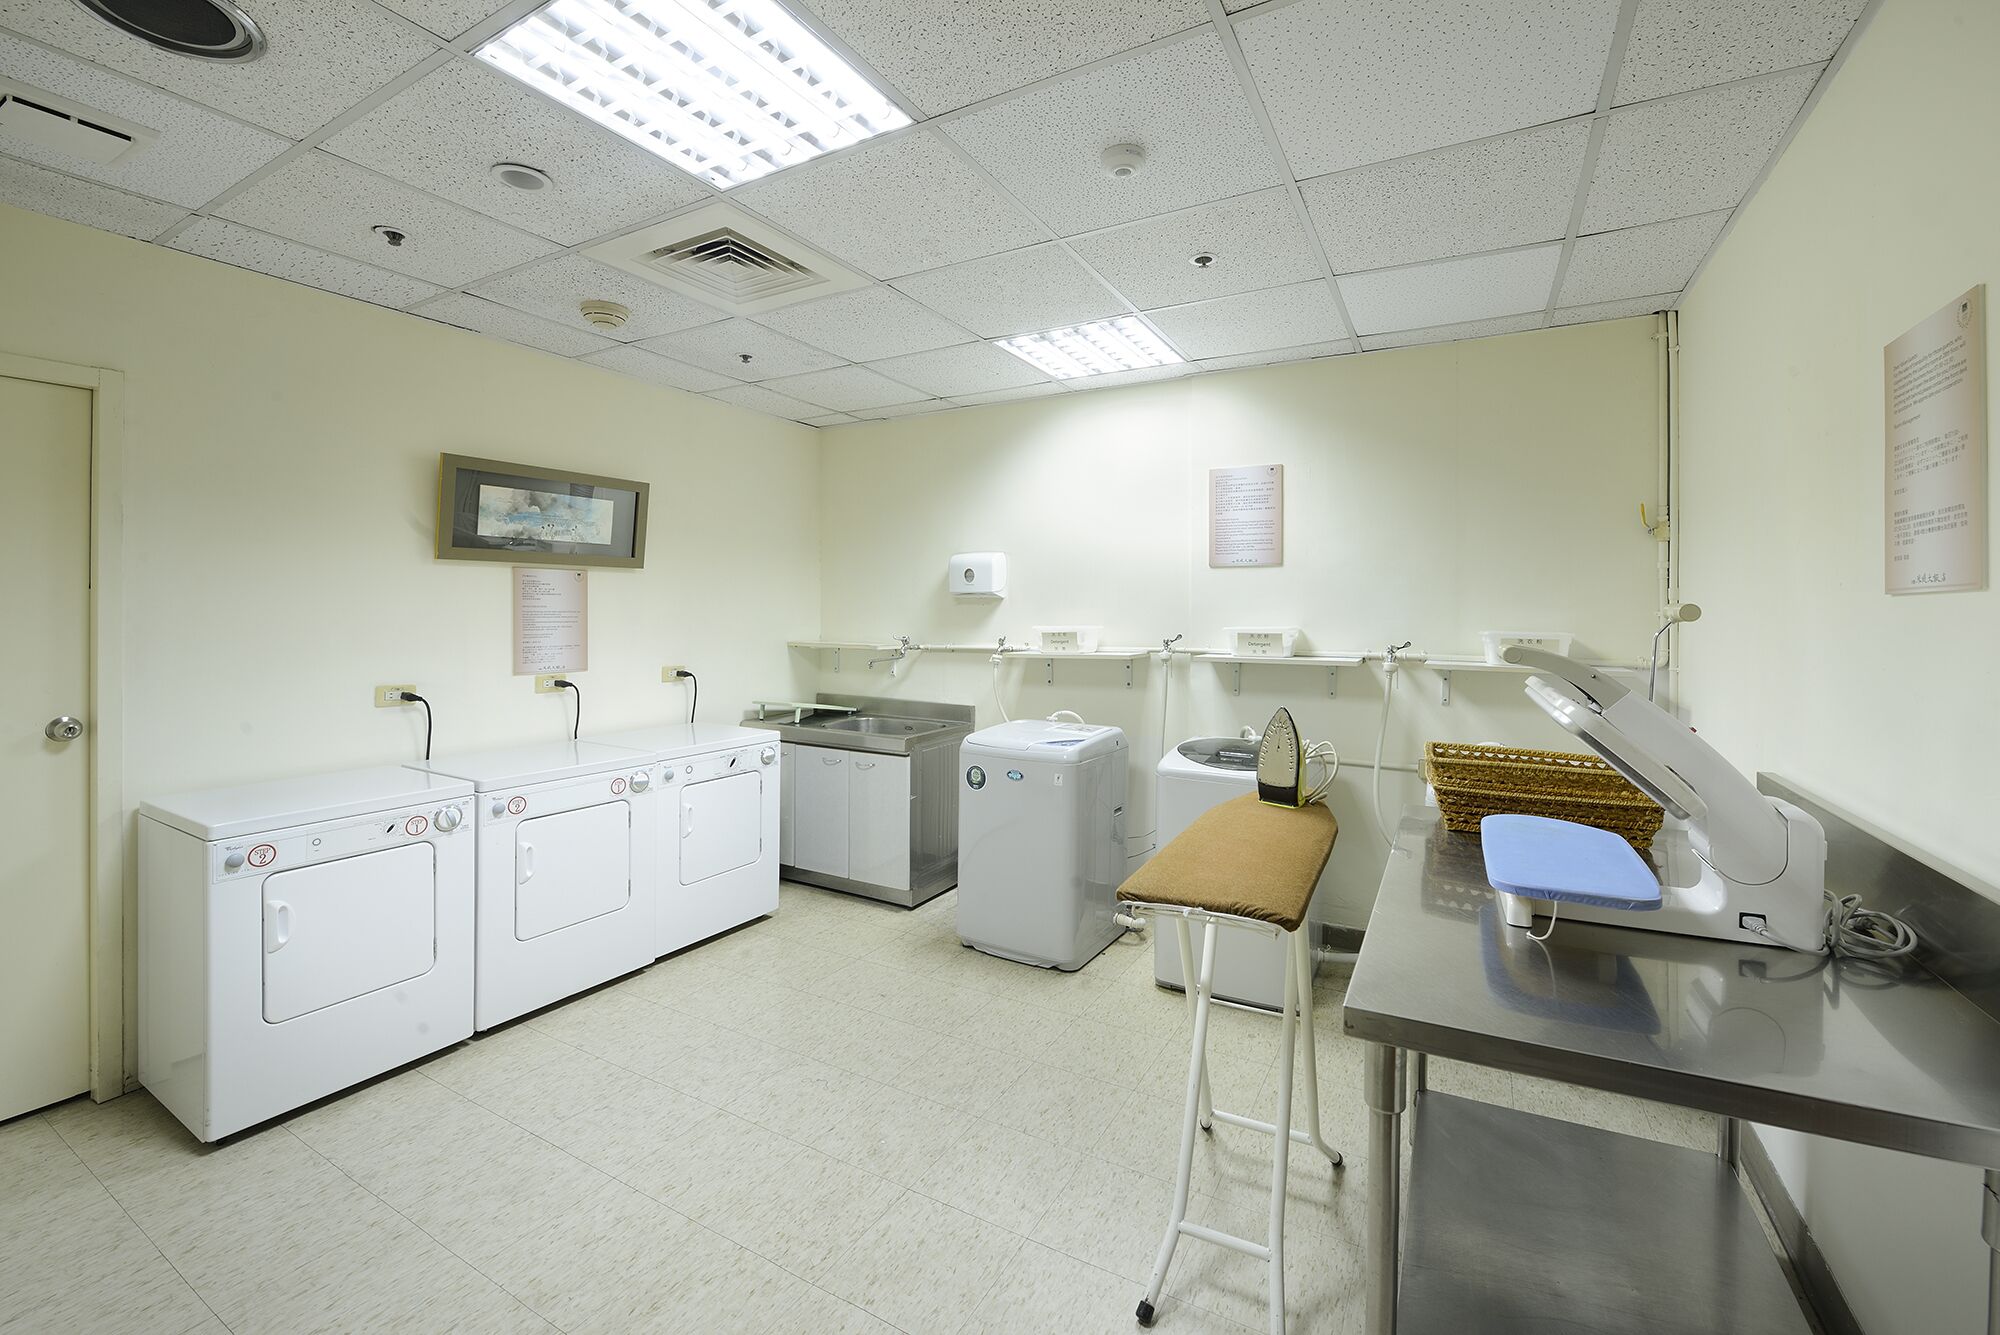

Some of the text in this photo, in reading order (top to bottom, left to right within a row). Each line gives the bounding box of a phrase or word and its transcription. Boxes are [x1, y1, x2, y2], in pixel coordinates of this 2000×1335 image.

[514, 804, 520, 812] 2
[254, 848, 271, 856] STEP
[259, 854, 266, 864] 2
